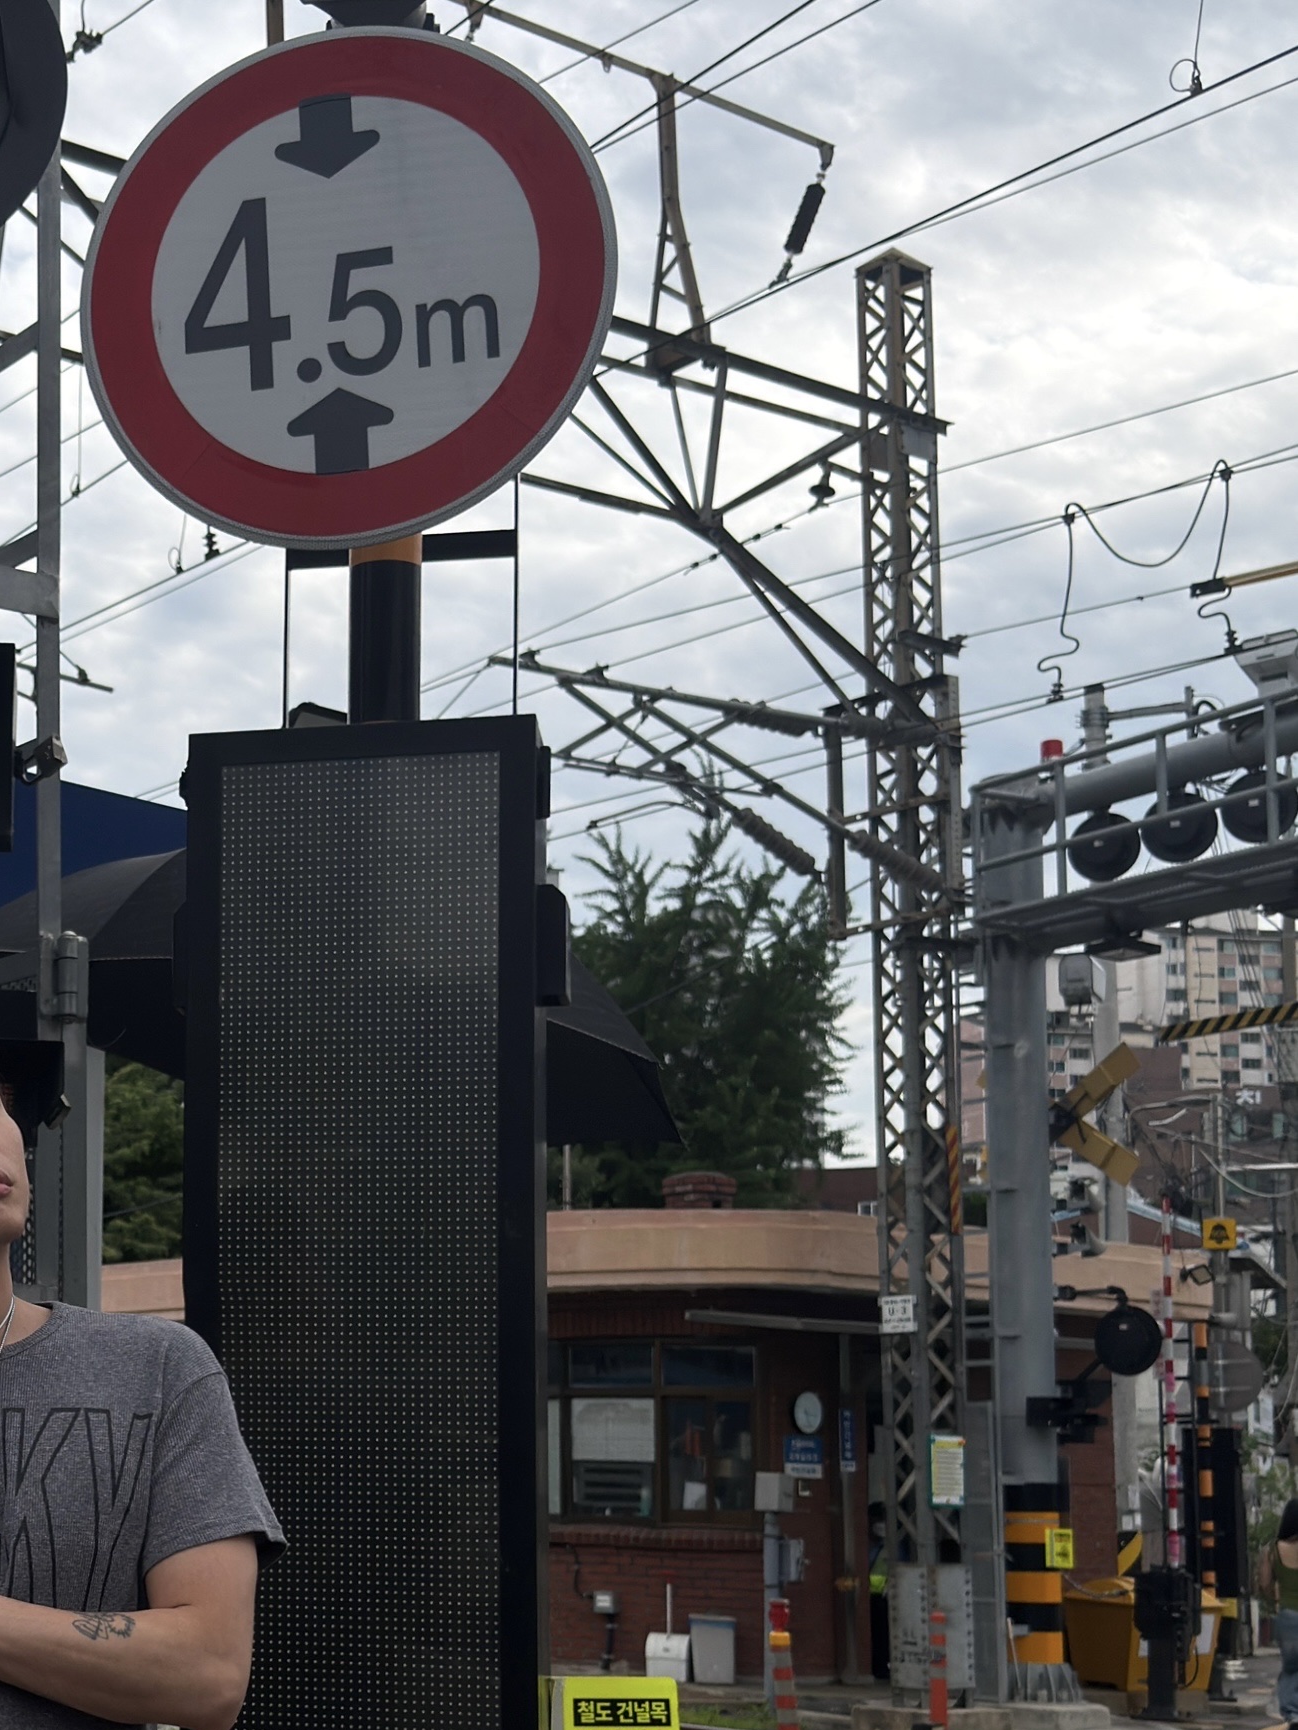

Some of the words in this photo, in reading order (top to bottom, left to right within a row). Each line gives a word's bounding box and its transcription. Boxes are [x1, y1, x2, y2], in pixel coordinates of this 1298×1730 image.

[184, 196, 501, 391] 4.5m
[577, 1701, 614, 1723] 철도
[616, 1701, 668, 1723] 건널목
